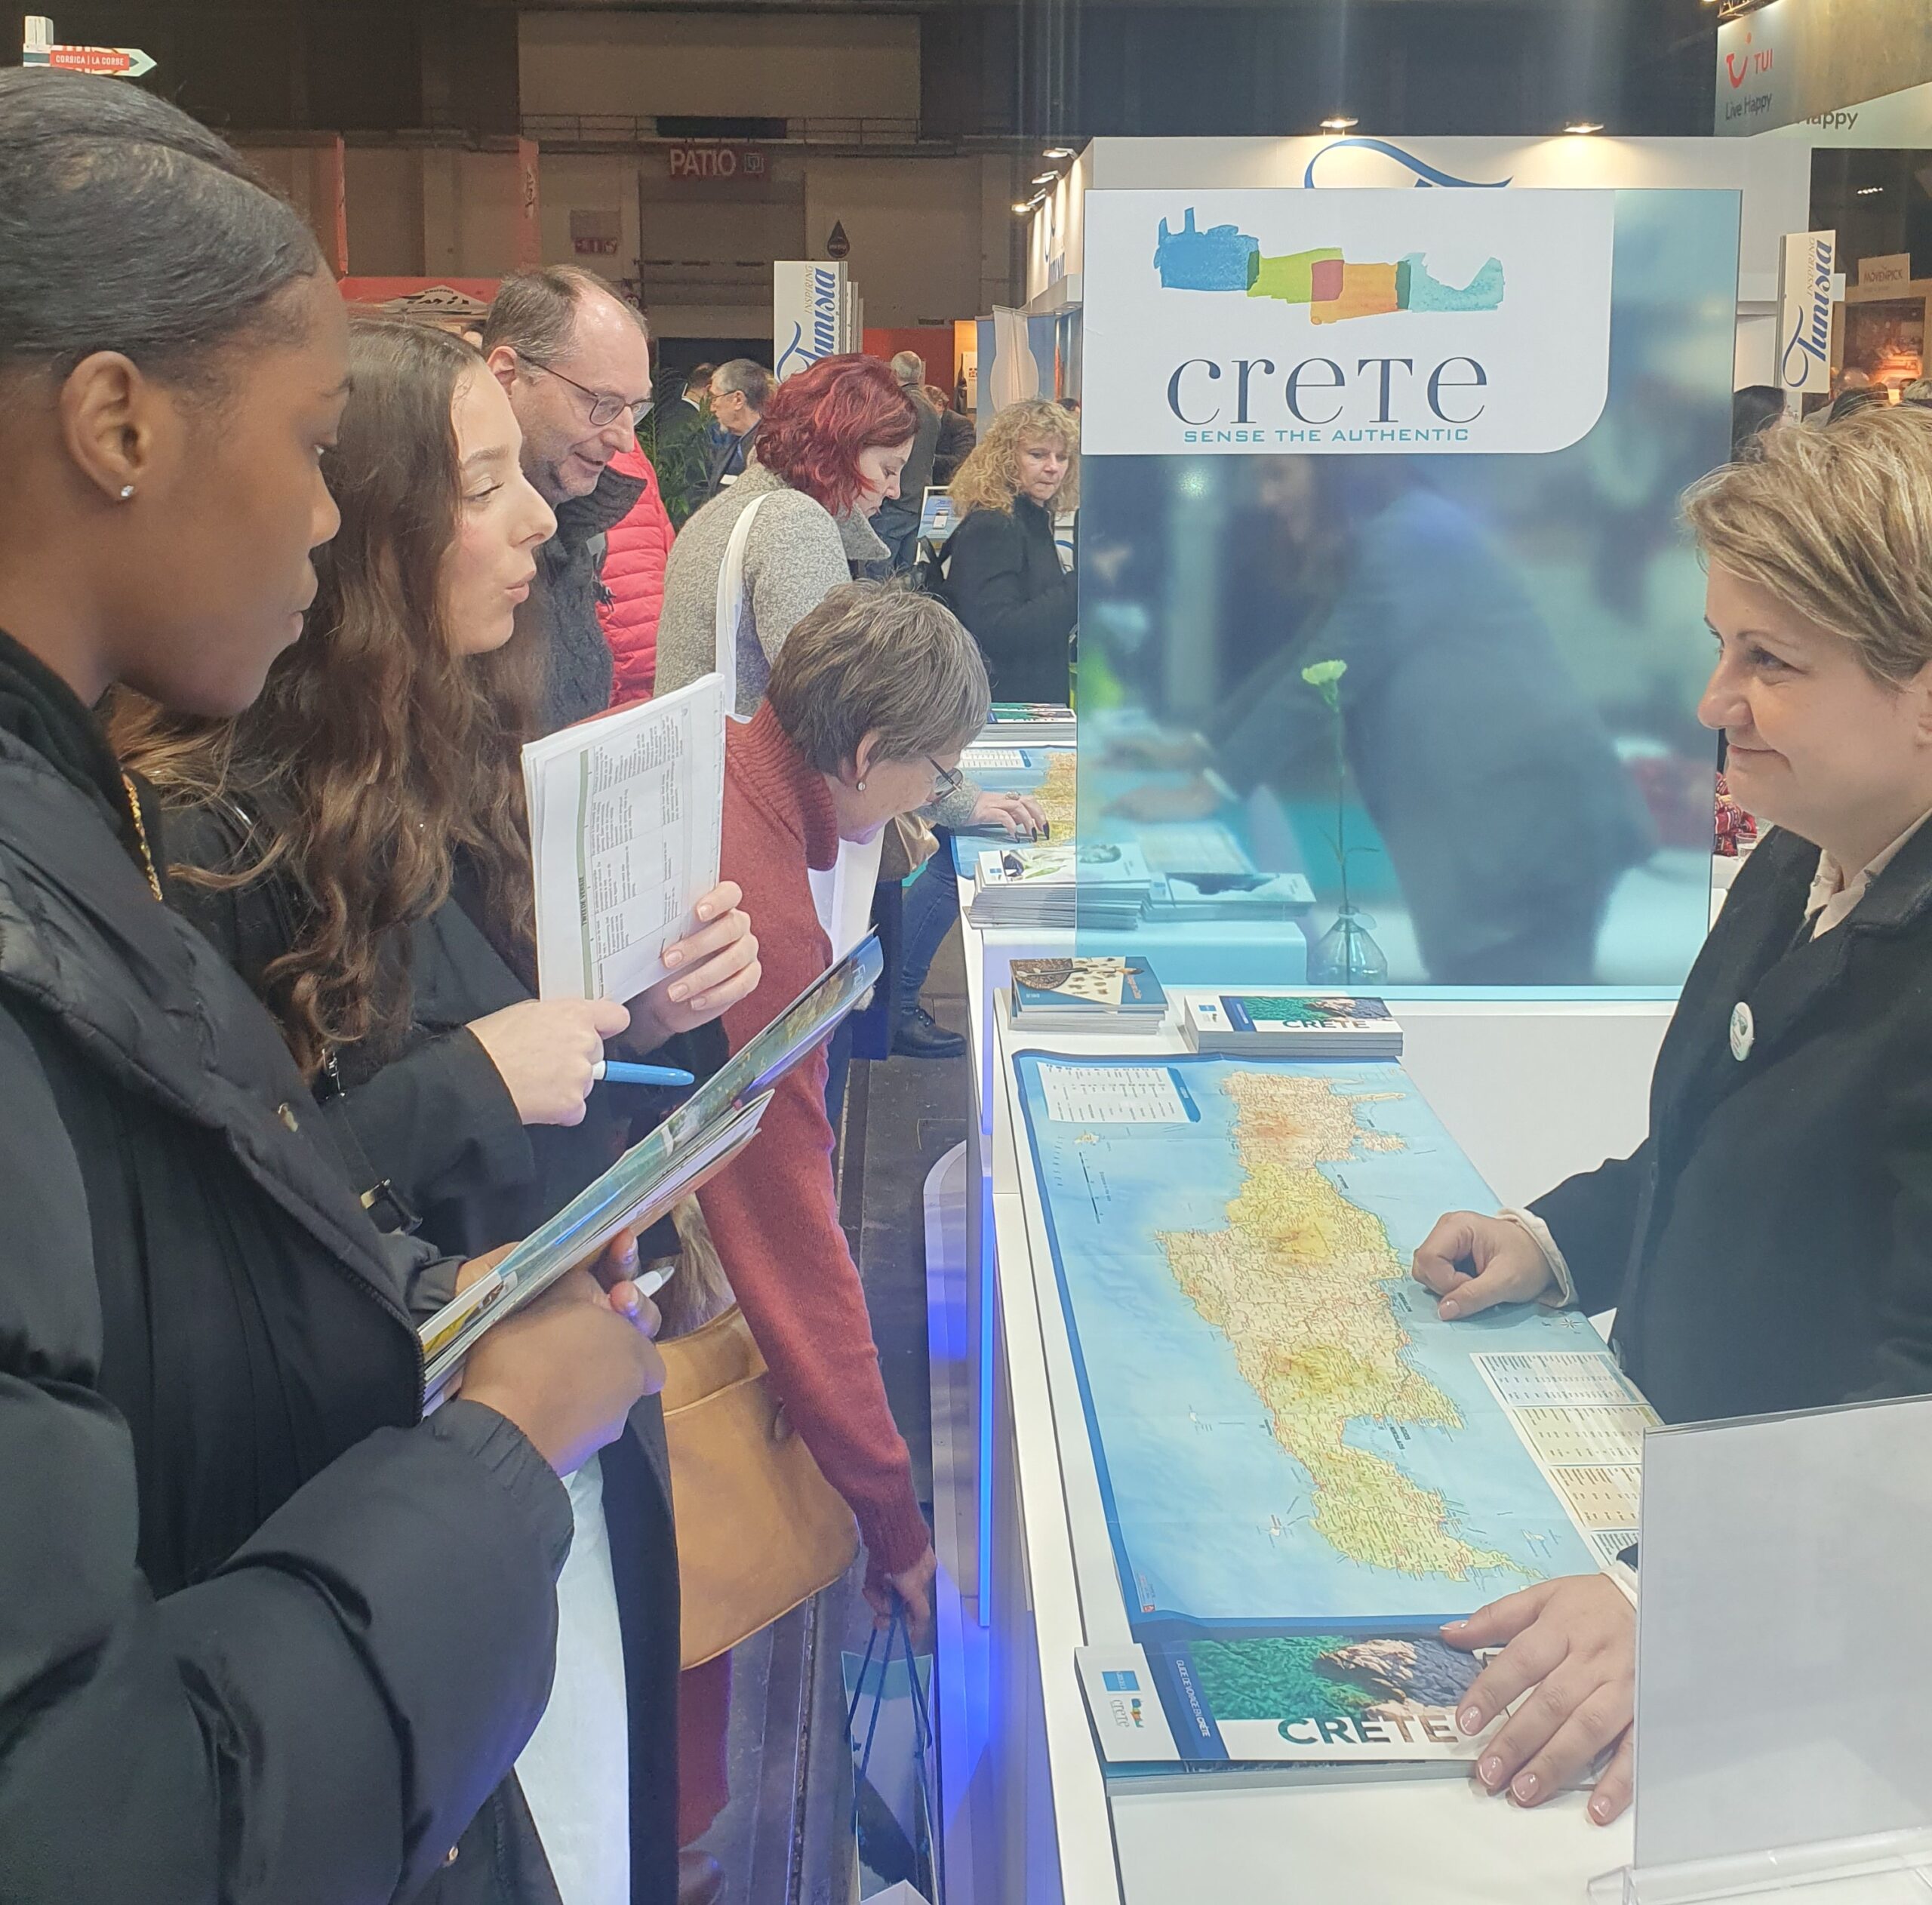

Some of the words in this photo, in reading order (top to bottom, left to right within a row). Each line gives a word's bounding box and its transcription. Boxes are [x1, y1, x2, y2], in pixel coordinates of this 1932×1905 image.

[56, 54, 85, 64] CORSICA
[91, 56, 100, 64] LA
[1754, 48, 1773, 74] TUI
[1726, 102, 1742, 121] Live
[1744, 93, 1772, 115] Happy
[1796, 111, 1858, 130] appy
[669, 148, 737, 176] PATIO
[1807, 236, 1816, 296] INSPIRING
[804, 264, 814, 315] INSPIRING
[1783, 239, 1832, 387] Tunisia
[1184, 429, 1266, 443] SENSE
[1275, 429, 1322, 442] THE
[1331, 428, 1469, 442] AUTHENTIC
[1282, 1017, 1371, 1029] CRETE
[1176, 1660, 1189, 1677] GUIDE
[1277, 1714, 1459, 1745] CRETE
